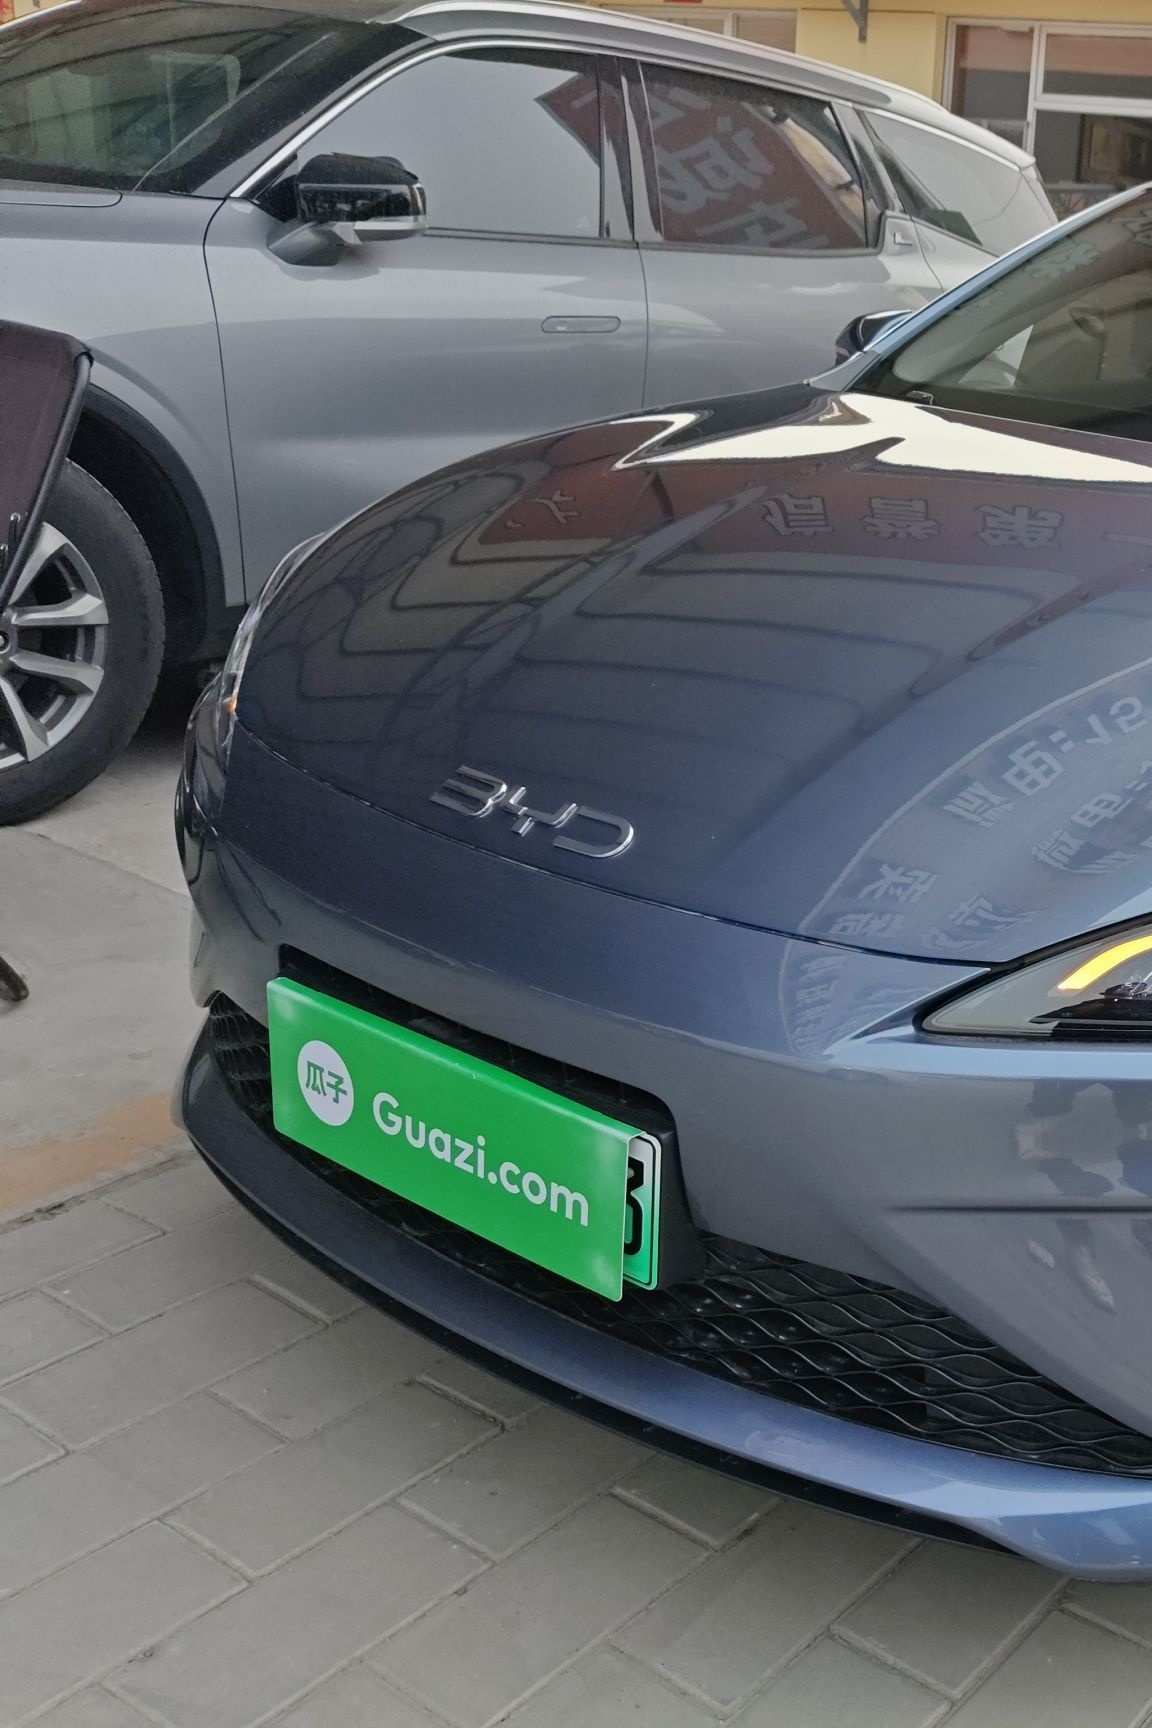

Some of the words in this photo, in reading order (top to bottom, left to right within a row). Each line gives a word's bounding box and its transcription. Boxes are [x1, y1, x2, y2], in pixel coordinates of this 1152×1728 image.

[430, 764, 634, 859] BYD
[304, 1060, 348, 1105] 瓜子
[372, 1092, 589, 1227] Guazi.com
